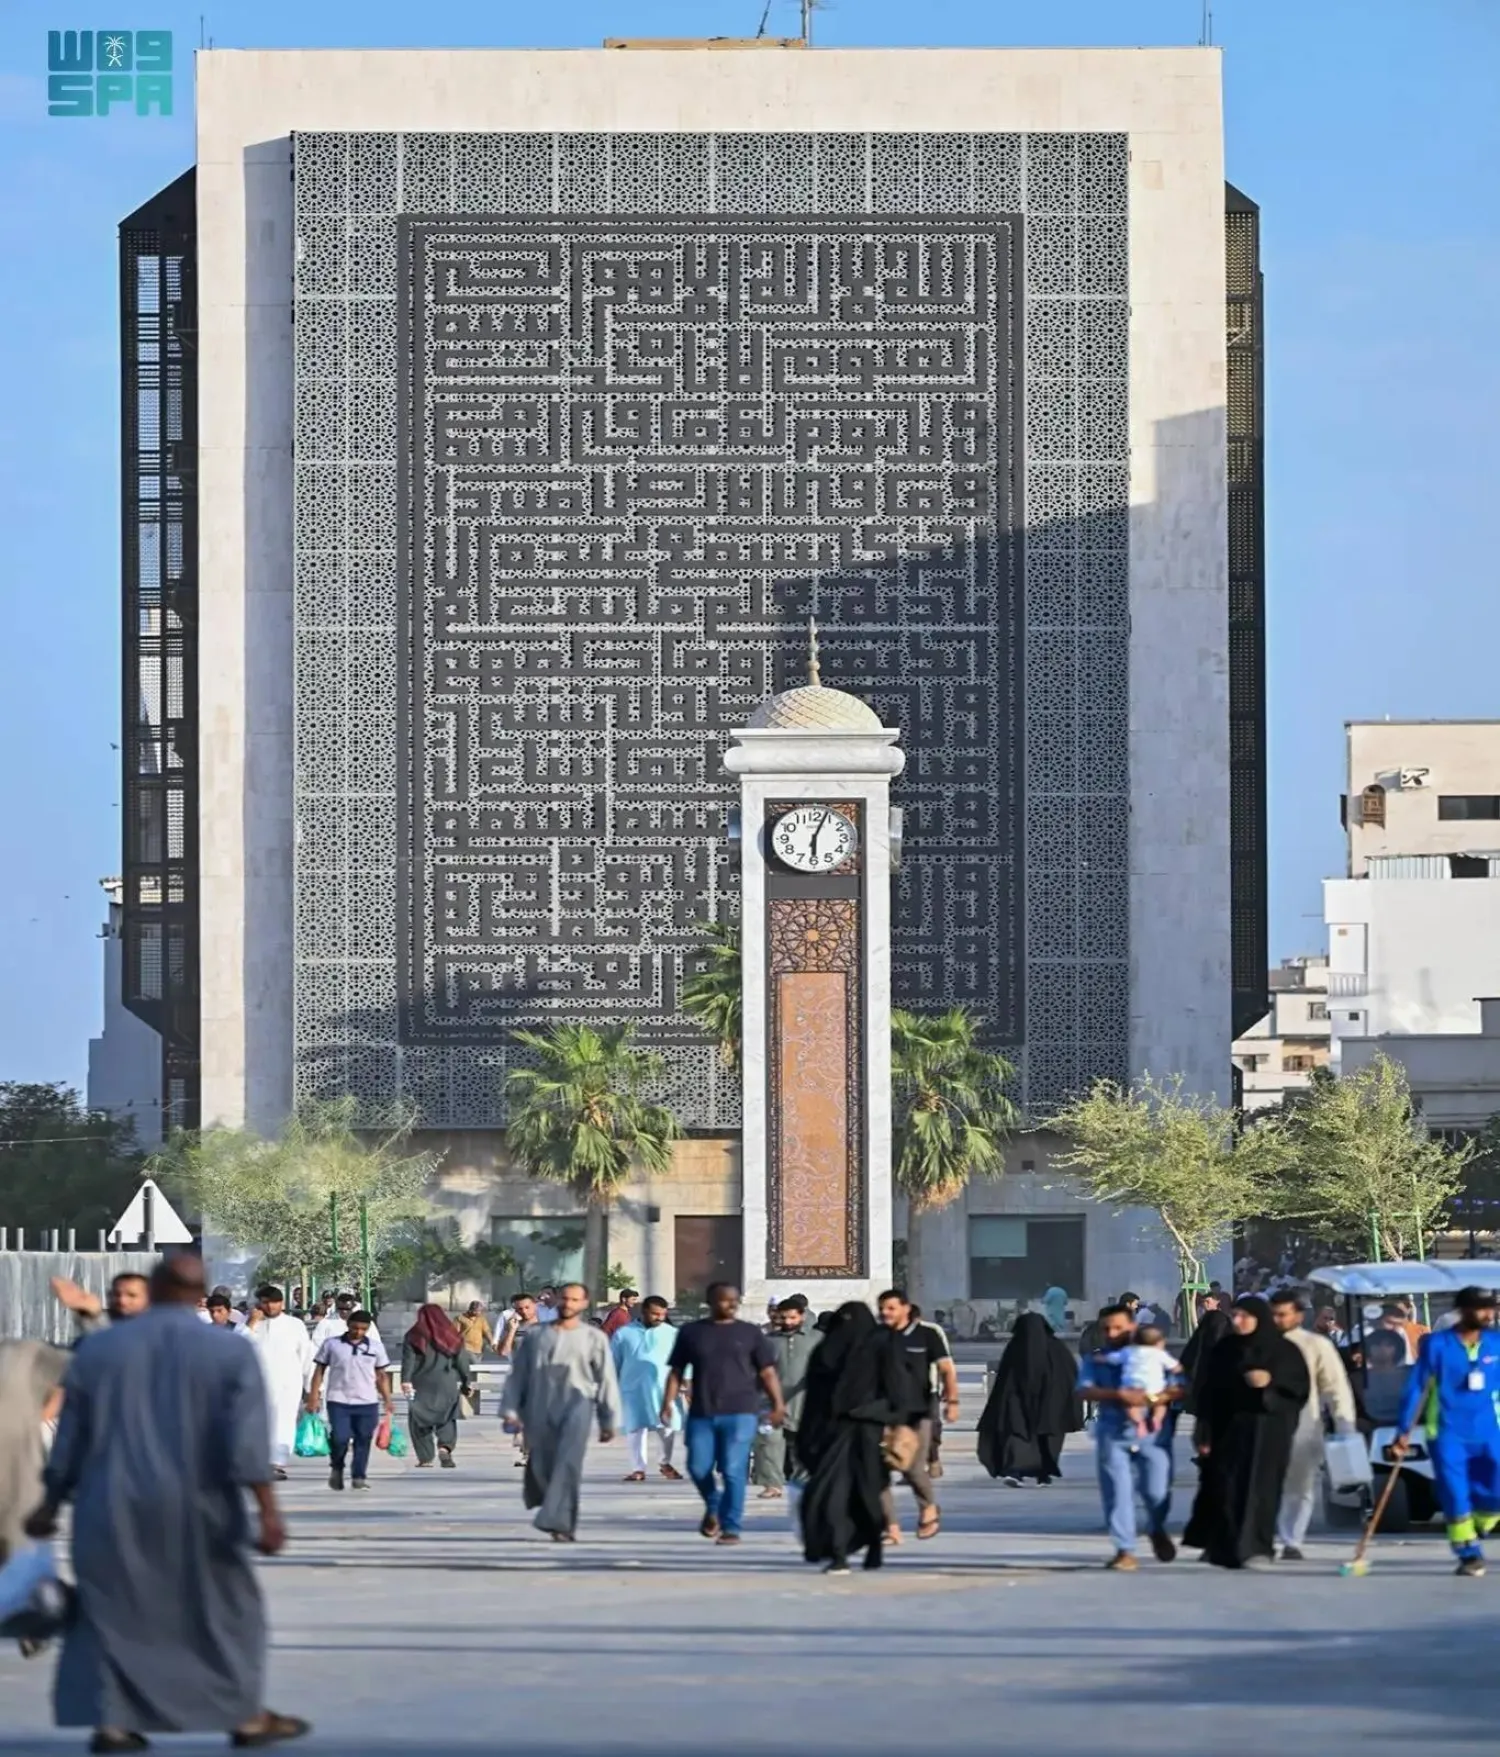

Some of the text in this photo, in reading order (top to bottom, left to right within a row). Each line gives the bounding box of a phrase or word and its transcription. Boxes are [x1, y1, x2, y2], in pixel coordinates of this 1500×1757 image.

[794, 812, 805, 824] 11
[808, 811, 821, 822] 12
[781, 822, 796, 832] 10
[835, 821, 844, 832] 2
[780, 833, 789, 844] 9
[839, 833, 848, 843] 3
[784, 844, 794, 854] 8
[834, 844, 843, 854] 4
[796, 853, 805, 863] 7
[808, 855, 818, 866] 6
[823, 853, 832, 863] 5
